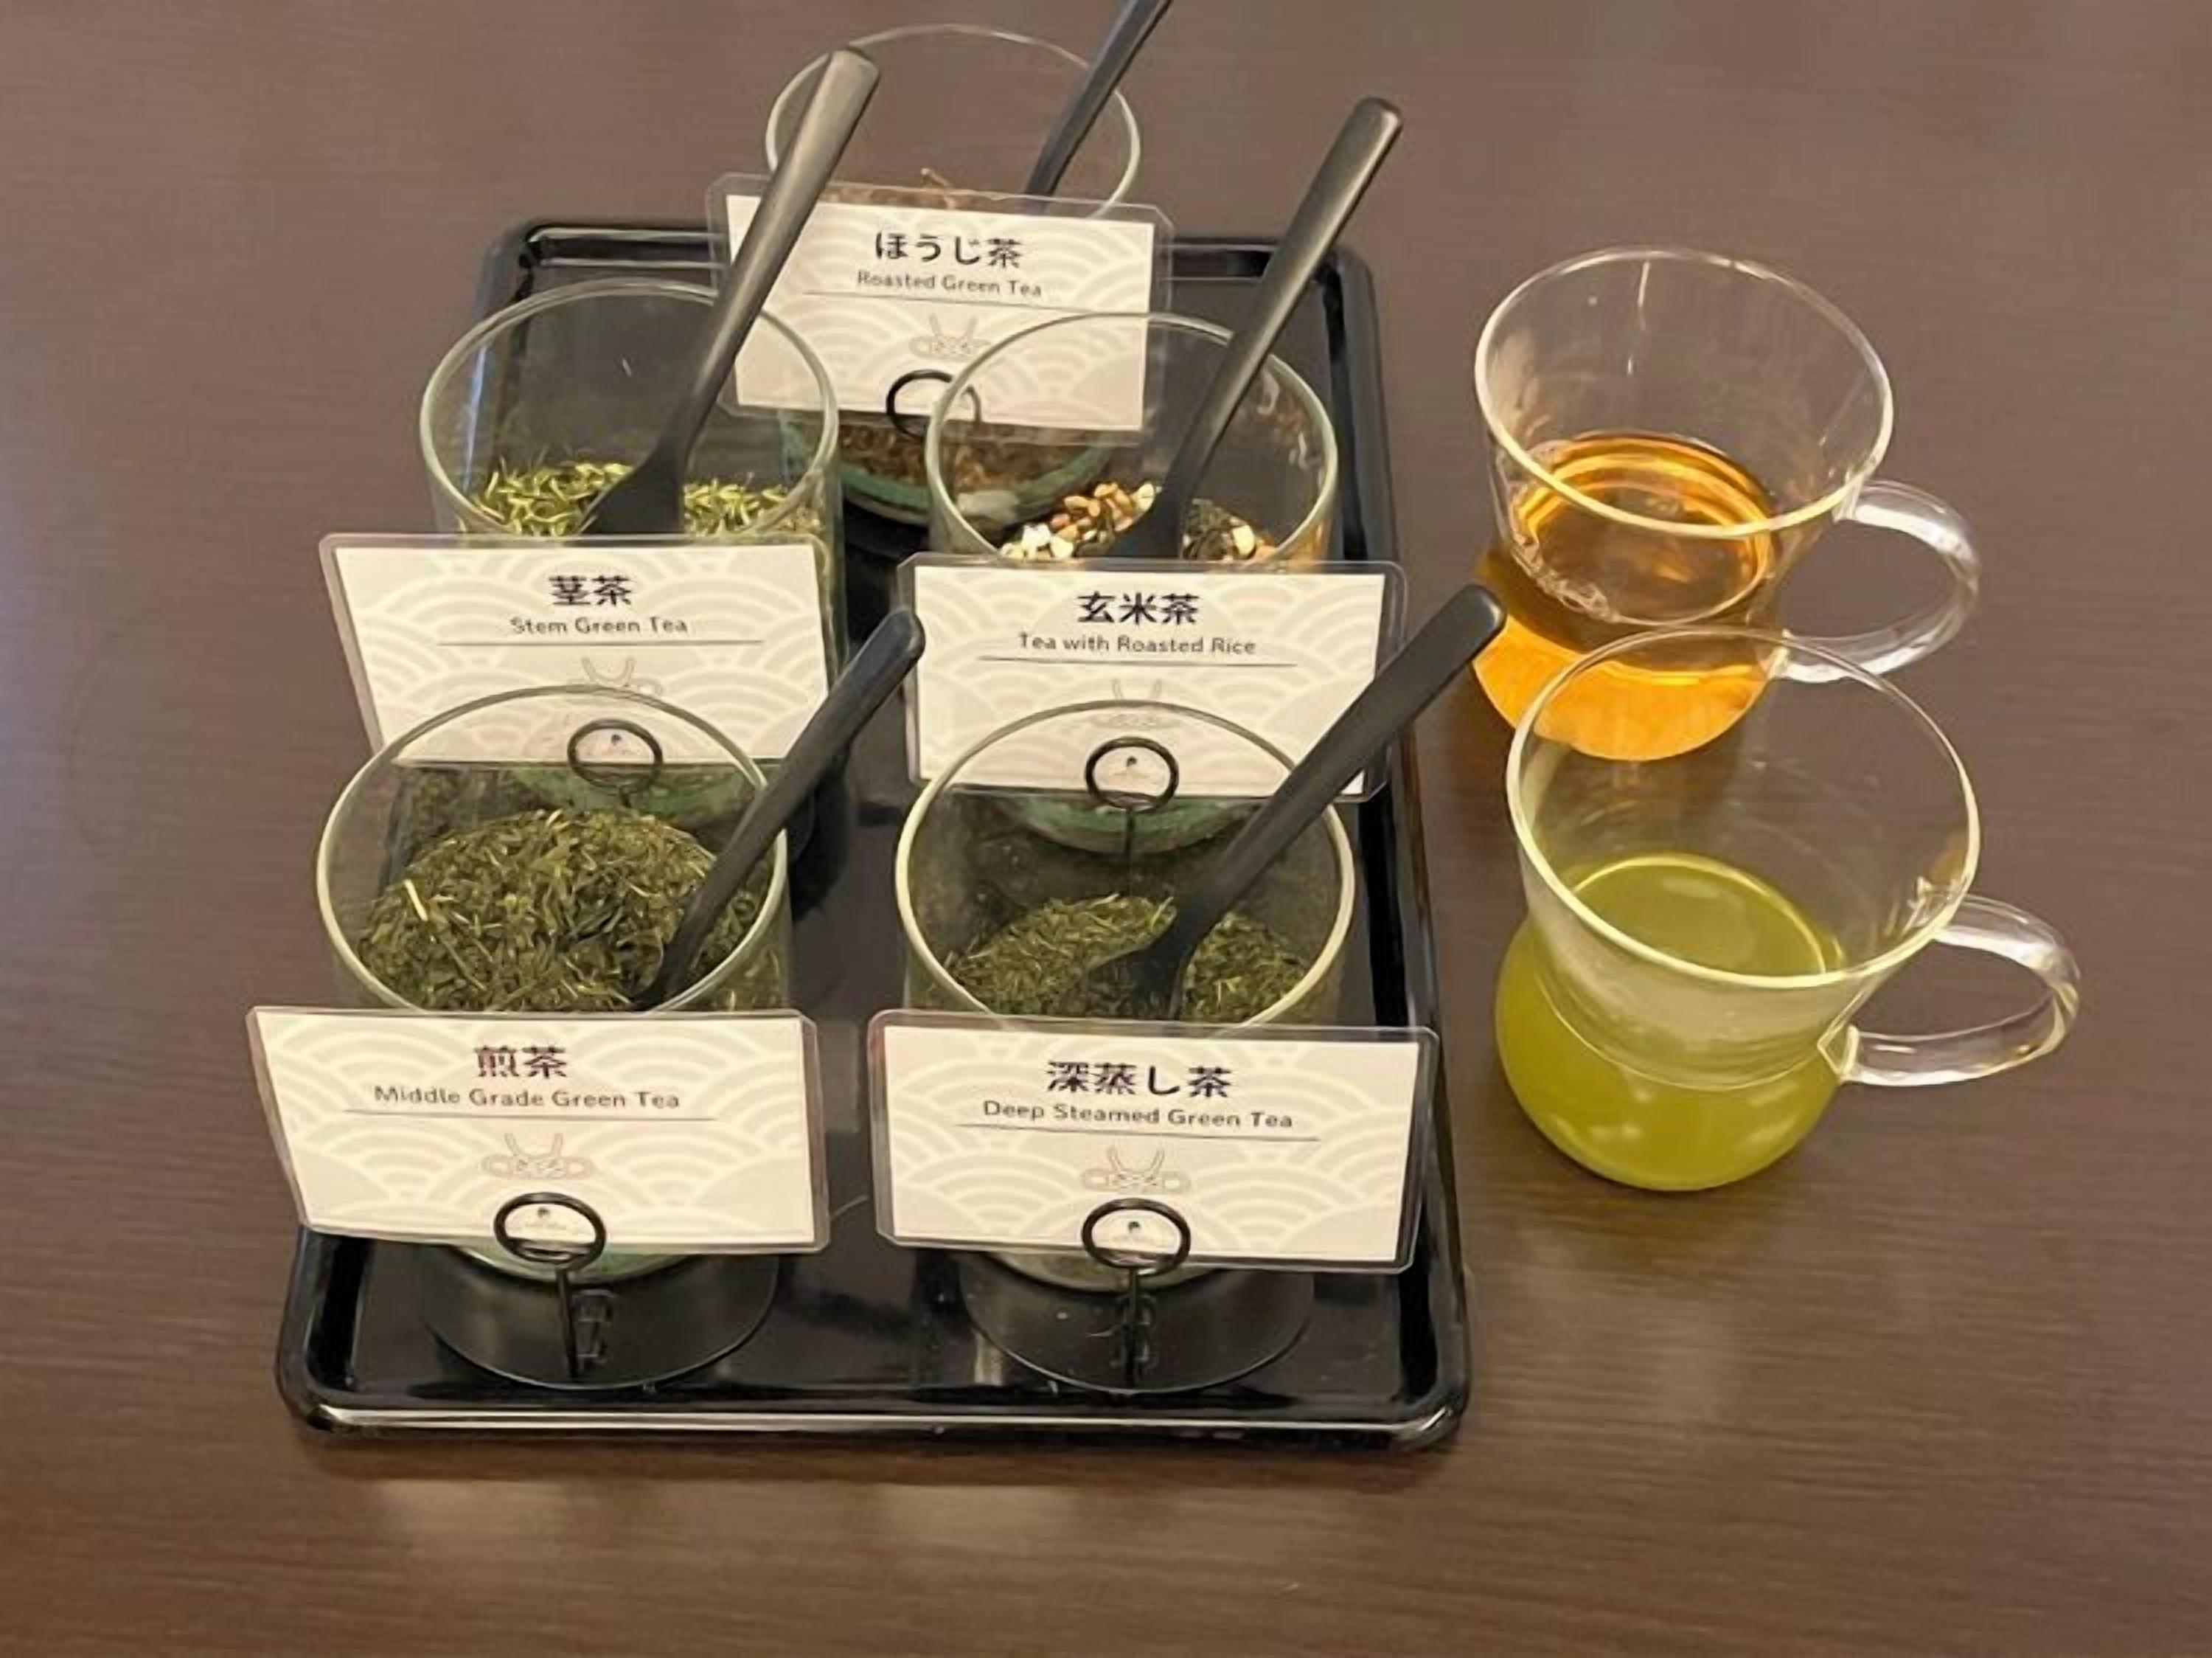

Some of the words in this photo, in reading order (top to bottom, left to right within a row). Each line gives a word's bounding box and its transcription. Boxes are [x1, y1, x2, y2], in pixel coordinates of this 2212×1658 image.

[875, 232, 1021, 268] ほうじ茶
[858, 270, 936, 289] Roasted
[941, 274, 1001, 294] Green
[1007, 280, 1042, 296] Tea
[549, 575, 632, 606] 茎茶
[1077, 591, 1200, 625] 玄米茶
[509, 617, 568, 634] Stem
[574, 617, 641, 634] Green
[649, 616, 688, 633] Tea
[1019, 631, 1057, 650] Tea
[1062, 635, 1110, 652] with
[1117, 634, 1204, 653] Roasted
[1210, 637, 1256, 655] Rice
[474, 1045, 567, 1079] 煎茶
[1046, 1061, 1231, 1098] 深蒸し茶
[374, 1086, 460, 1104] Middle
[468, 1088, 543, 1107] Grade
[551, 1089, 626, 1107] Green
[635, 1091, 680, 1109] Tea
[983, 1100, 1045, 1121] Deep
[1053, 1103, 1160, 1124] Steamed
[1167, 1109, 1241, 1127] Green
[1251, 1111, 1293, 1128] Tea
